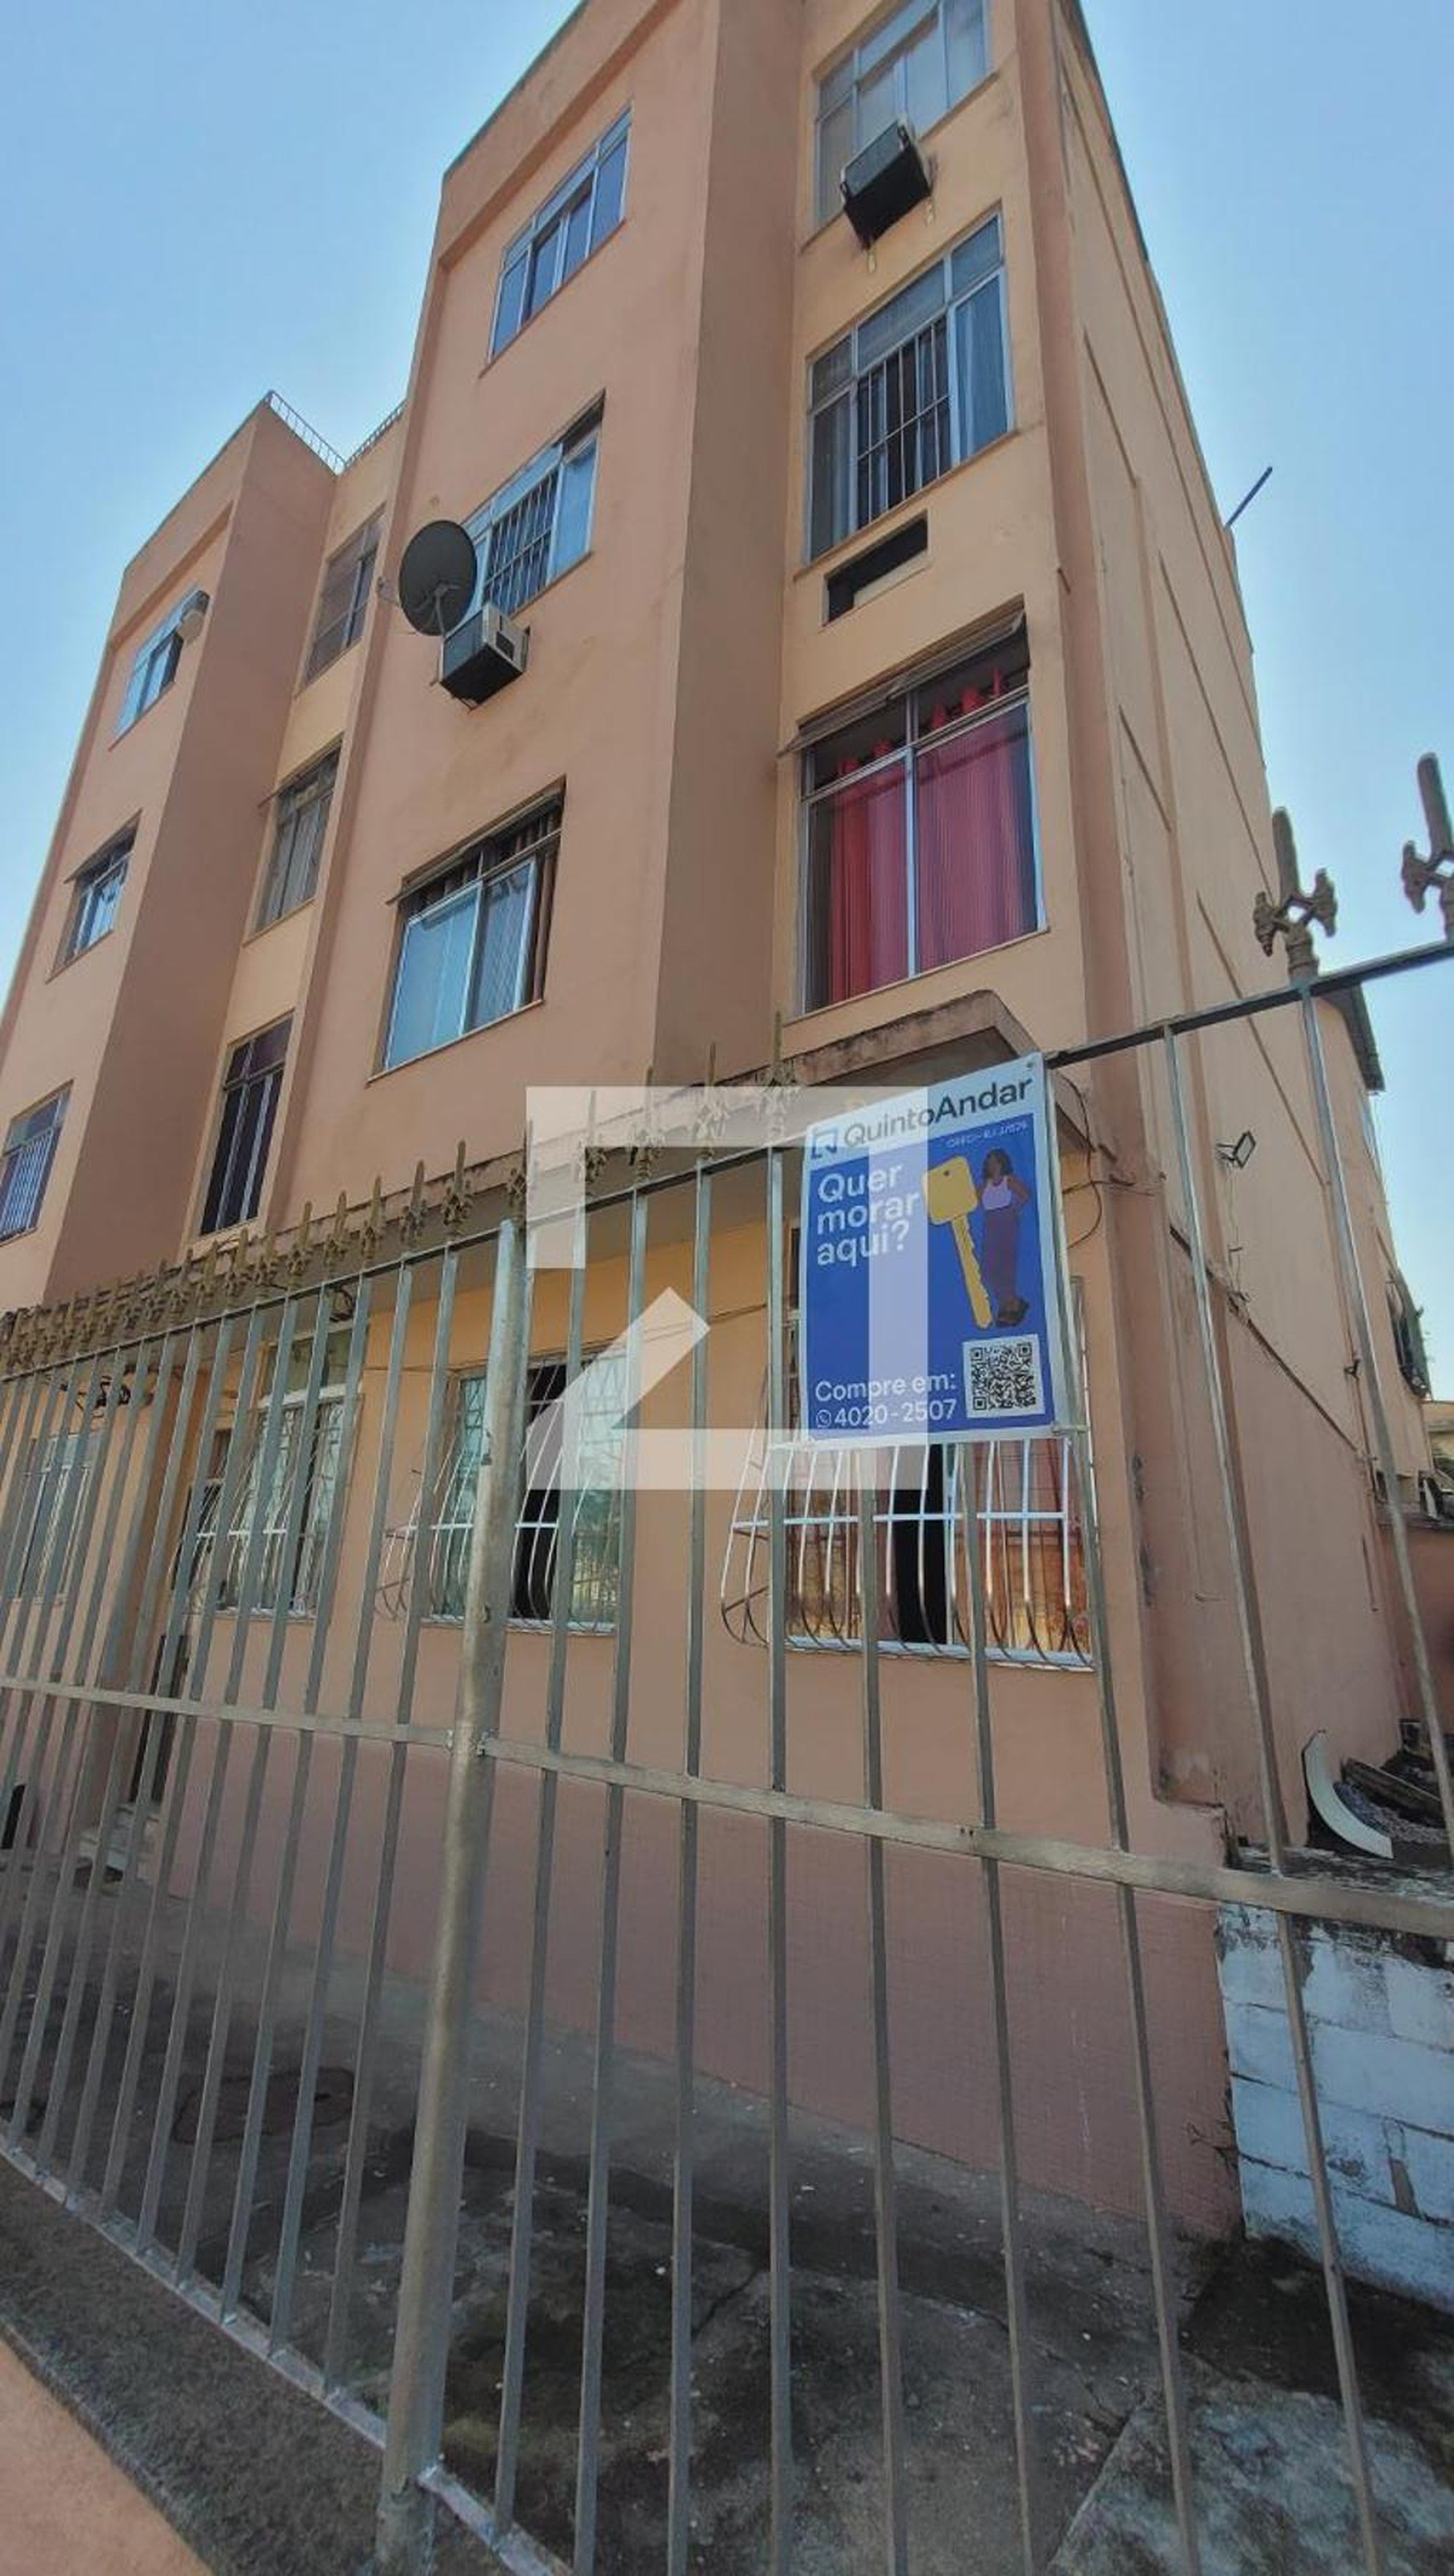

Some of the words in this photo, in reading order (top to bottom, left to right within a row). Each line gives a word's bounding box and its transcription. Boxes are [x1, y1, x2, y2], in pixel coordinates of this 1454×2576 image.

[844, 1078, 1033, 1148] QuintoAndar
[818, 1165, 902, 1203] Quer
[817, 1192, 919, 1235] morar
[817, 1219, 910, 1267] aqui?
[815, 1377, 905, 1402] Compre
[912, 1373, 956, 1394] em:
[835, 1398, 957, 1427] 4020-2507
